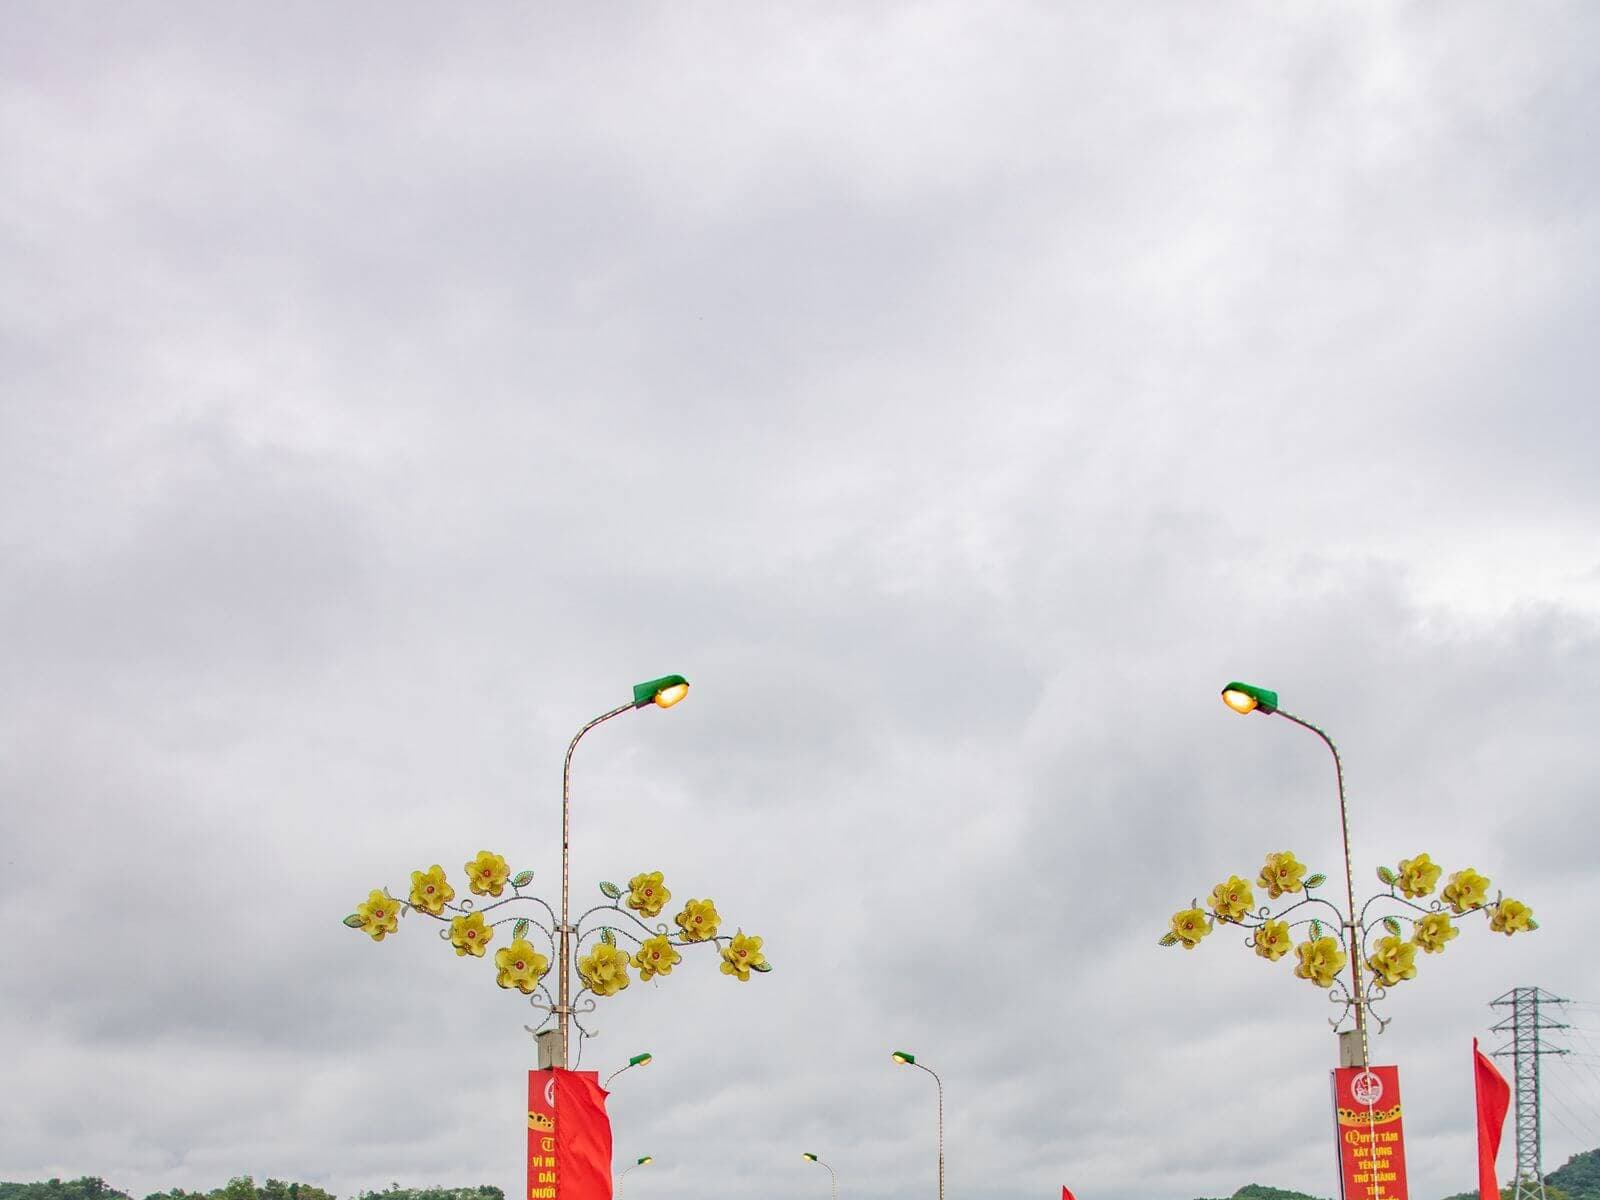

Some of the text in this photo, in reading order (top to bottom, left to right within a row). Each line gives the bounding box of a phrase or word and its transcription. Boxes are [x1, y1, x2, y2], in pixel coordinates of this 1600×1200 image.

[1345, 1130, 1398, 1145] QUYT TÂM
[1353, 1147, 1368, 1157] XÂY
[533, 1155, 542, 1168] VÌ
